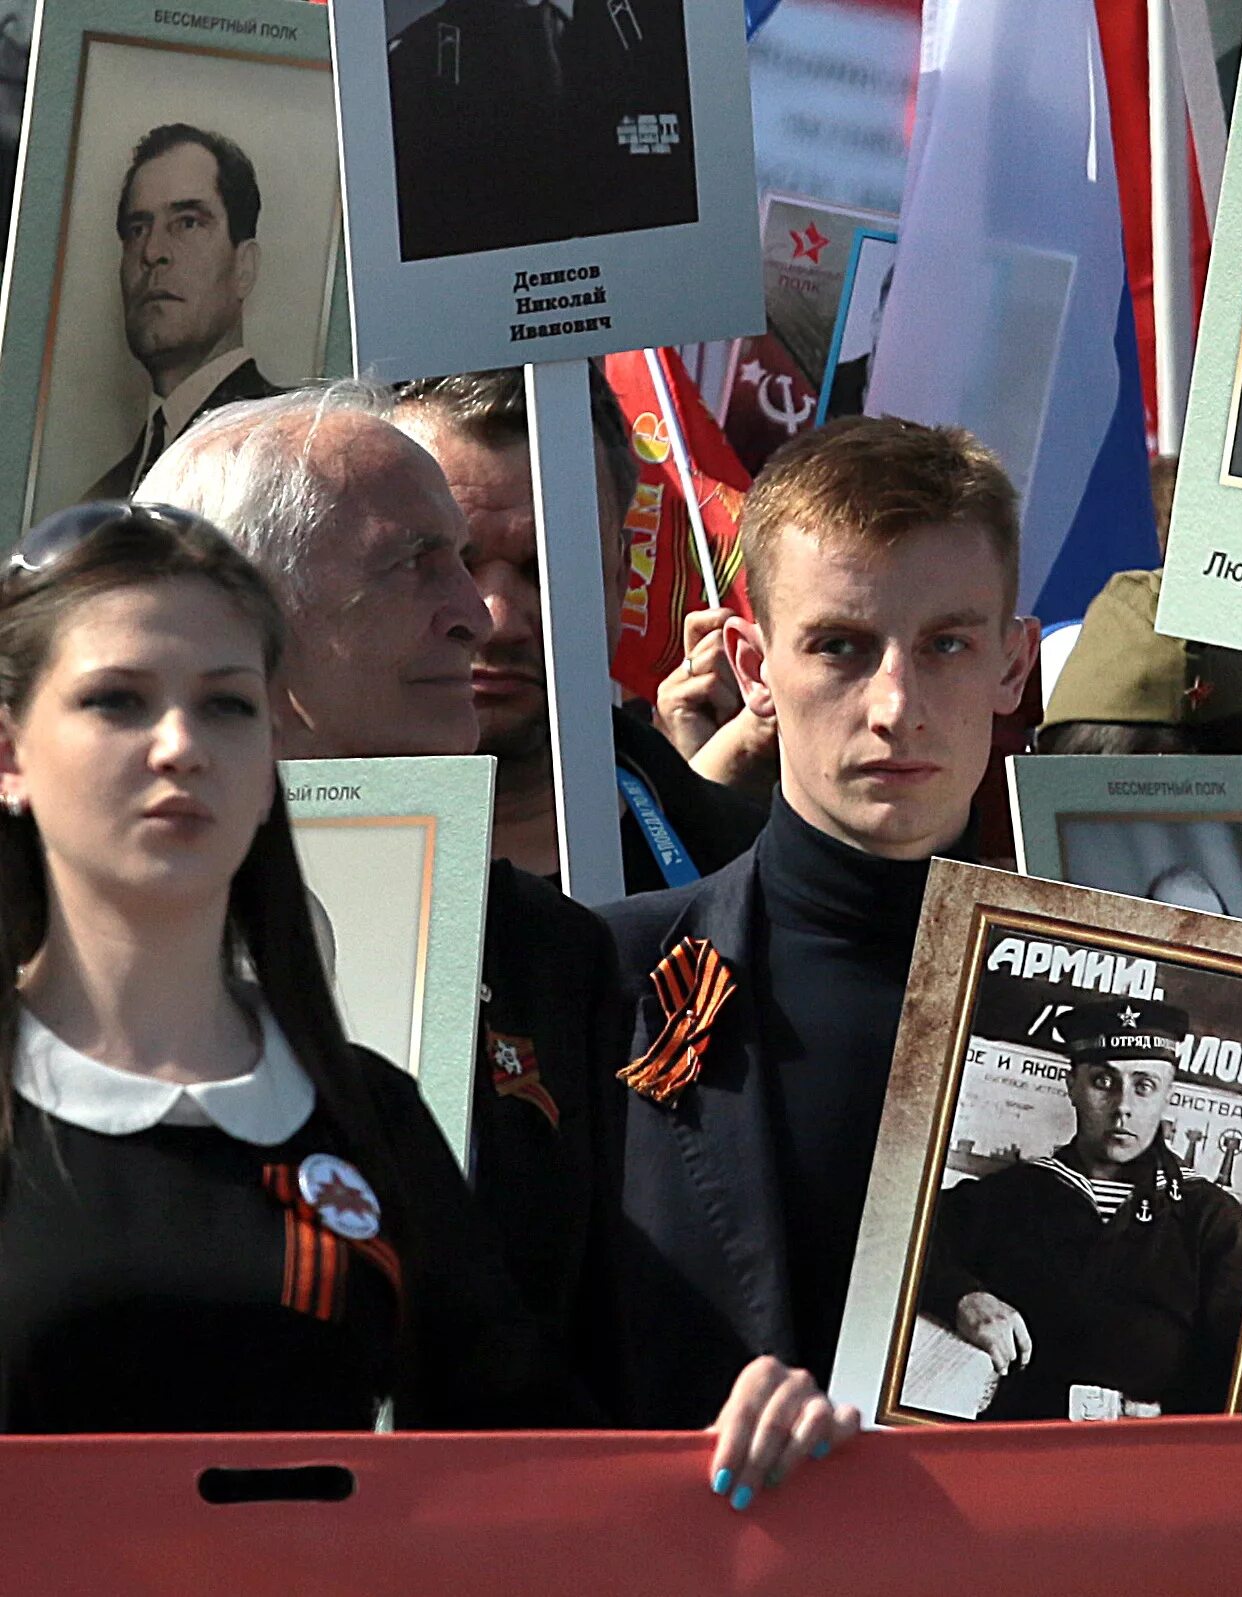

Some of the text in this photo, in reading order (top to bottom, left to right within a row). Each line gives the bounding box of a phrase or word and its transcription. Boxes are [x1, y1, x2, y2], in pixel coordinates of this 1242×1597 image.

[154, 9, 298, 41] БЕССМЕРТНЫЙ ПОЛК
[513, 265, 601, 293] Денисов
[516, 285, 607, 315] Николай
[509, 316, 612, 341] Иванович
[316, 785, 361, 800] ПОЛК
[1107, 780, 1227, 796] БЕССМЕРТНЫЙ ПОЛК
[1110, 1035, 1152, 1049] ОТРЯД
[997, 1055, 1011, 1070] И
